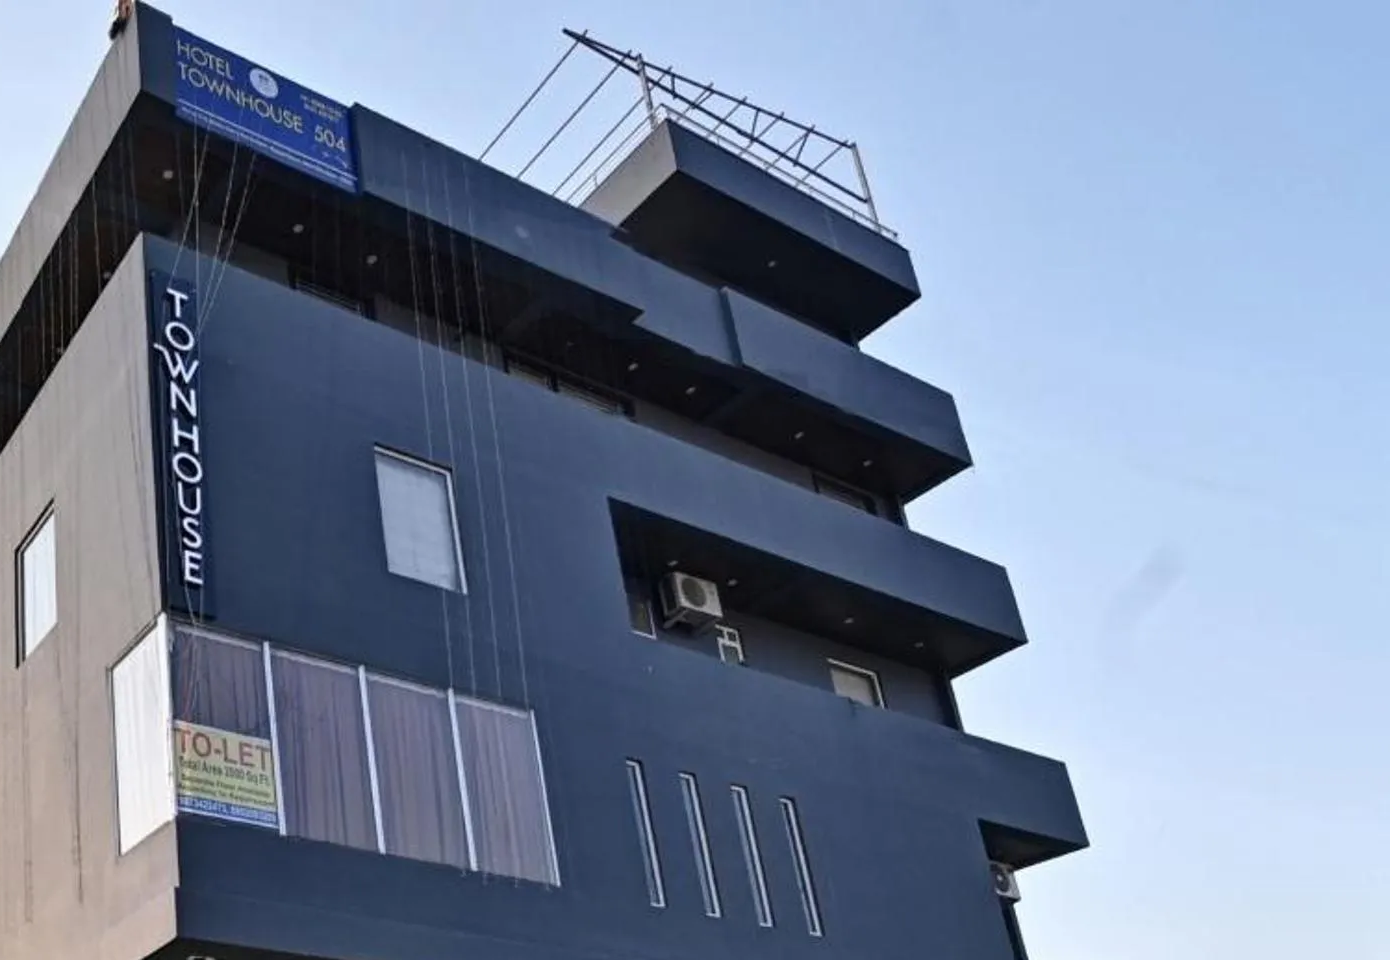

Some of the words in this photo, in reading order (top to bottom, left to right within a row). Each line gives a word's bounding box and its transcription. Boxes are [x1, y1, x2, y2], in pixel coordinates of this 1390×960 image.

[176, 39, 234, 80] HOTEL
[177, 61, 304, 135] TOWNHOUSE
[313, 124, 347, 153] 504
[153, 287, 203, 585] TOWNHOUSE
[175, 727, 272, 772] TO-LET
